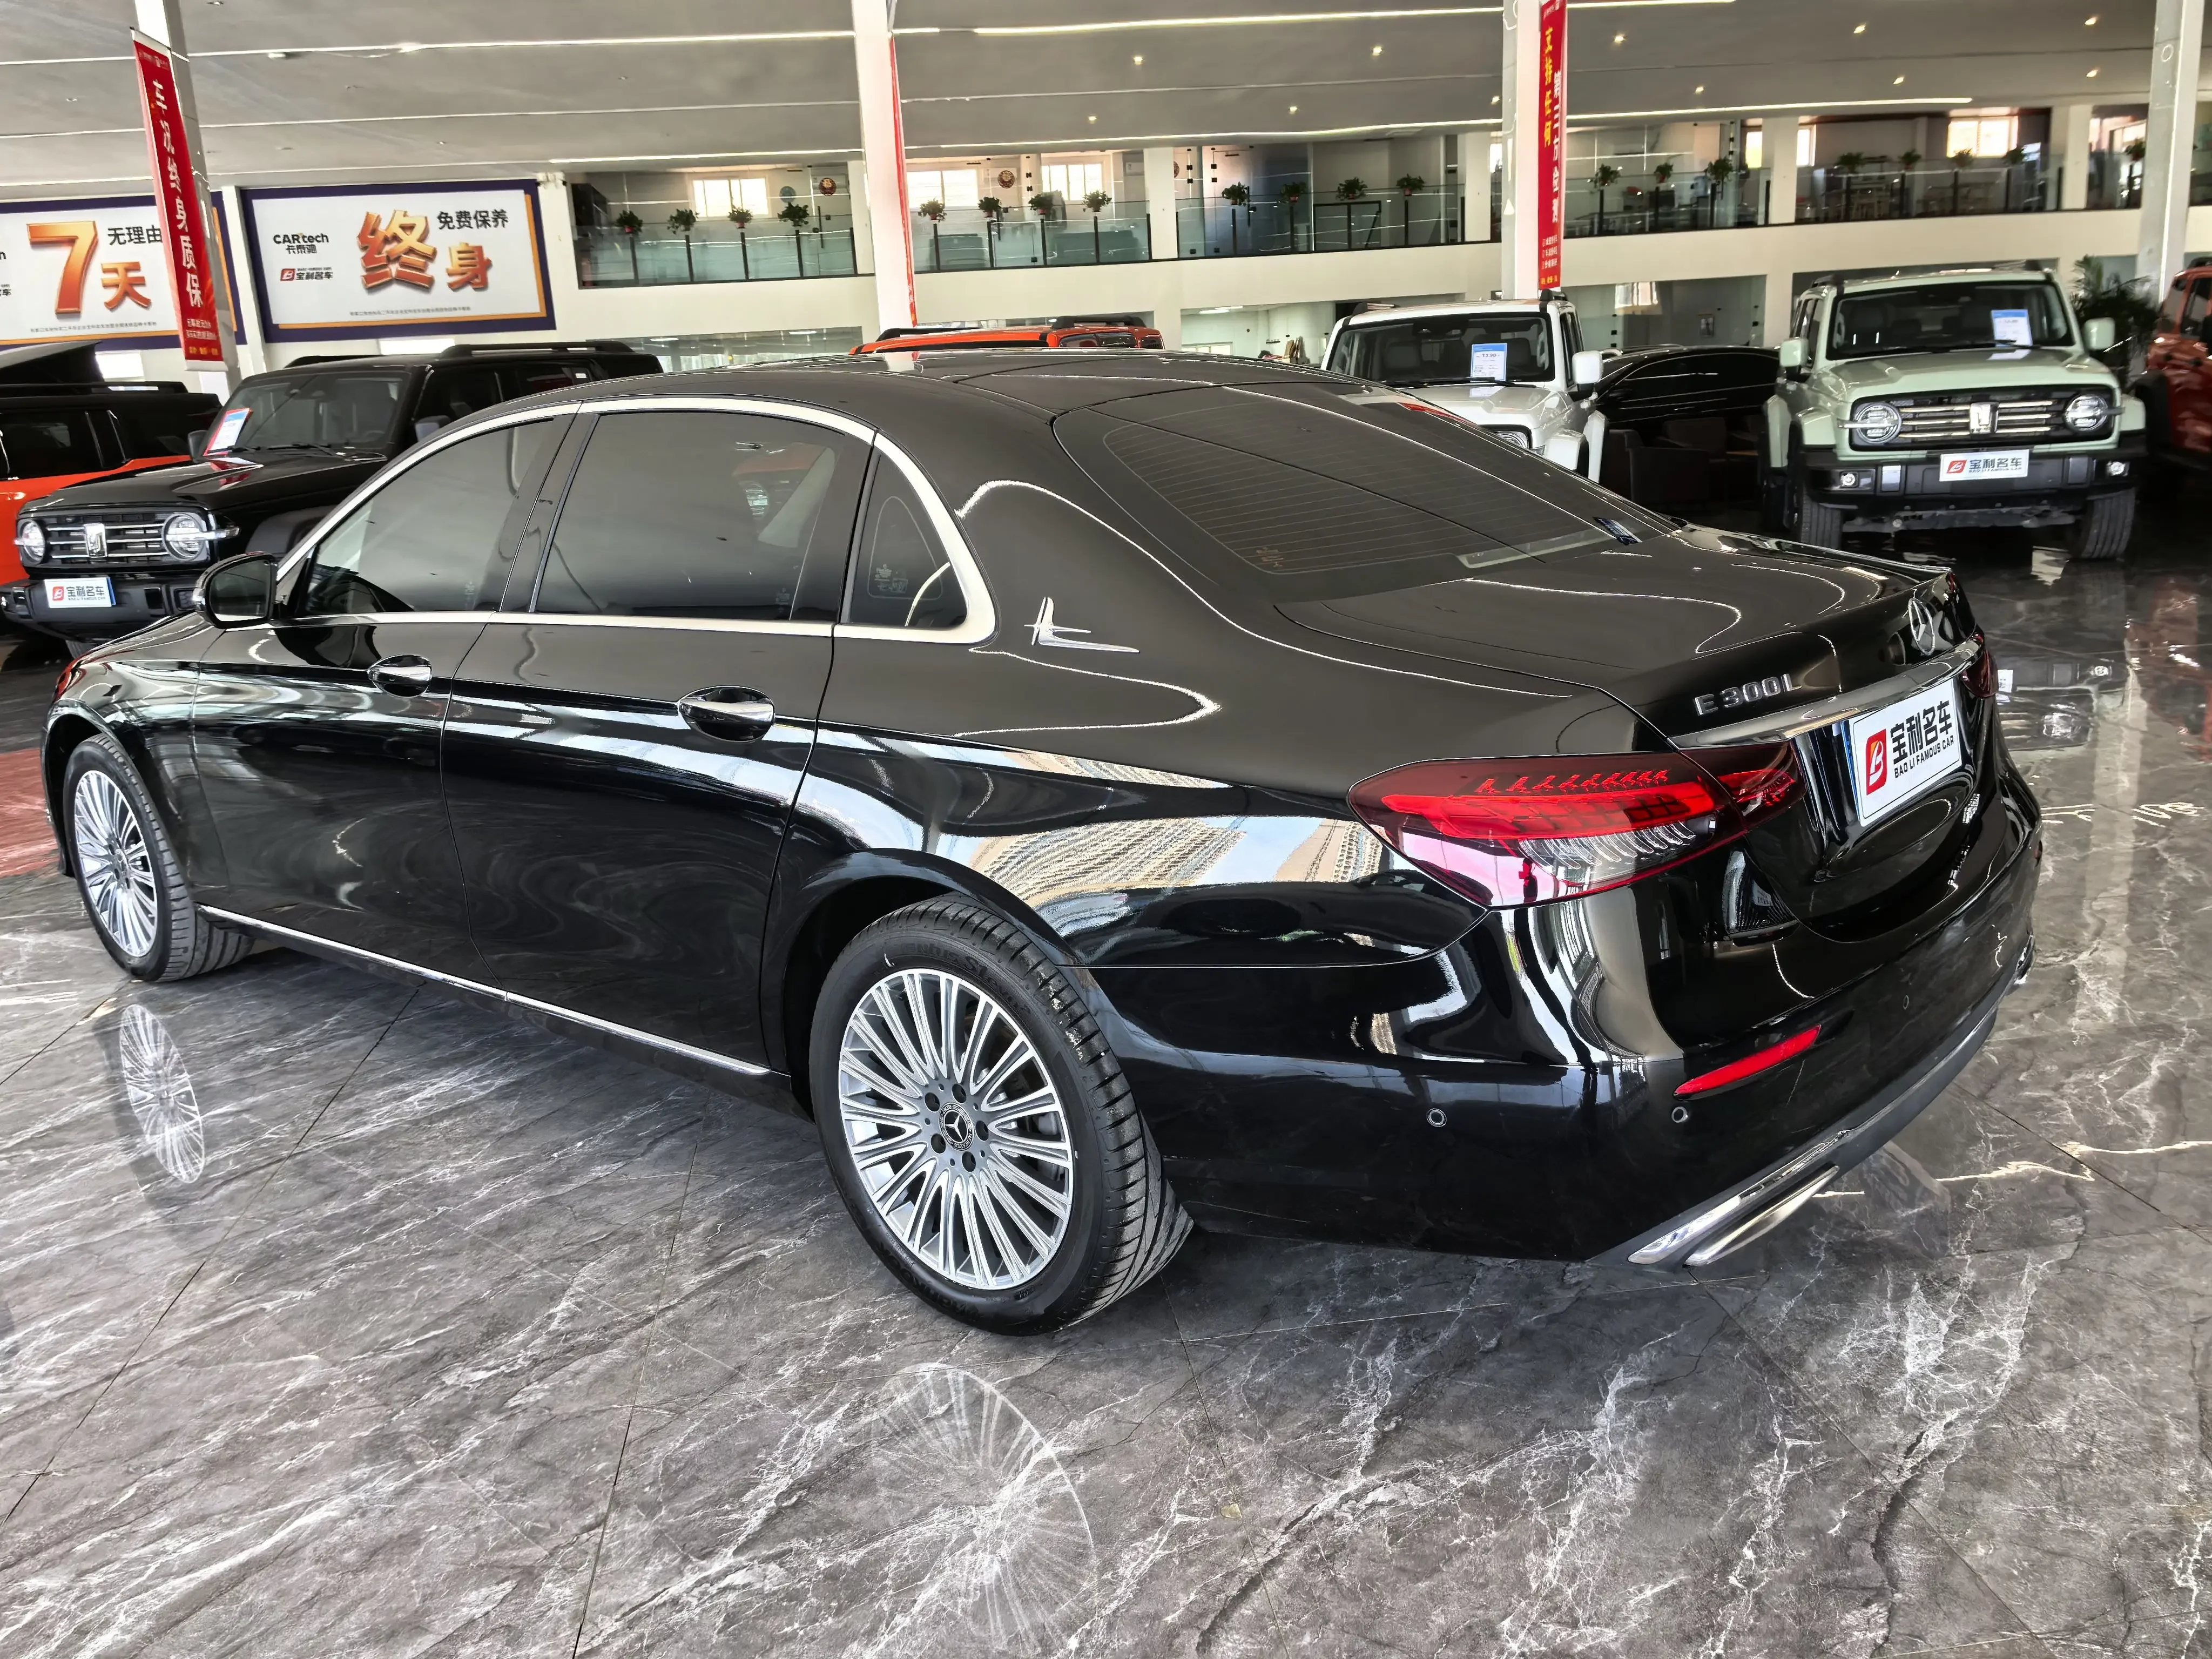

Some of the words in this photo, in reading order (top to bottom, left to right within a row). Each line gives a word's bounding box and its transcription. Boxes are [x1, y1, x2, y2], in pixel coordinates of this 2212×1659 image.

[437, 209, 509, 230] 免费保养
[107, 224, 163, 245] 无理由
[273, 233, 329, 245] CARtech
[357, 210, 493, 291] 终身
[1969, 457, 2022, 469] 宝利名车
[66, 586, 105, 597] 宝利名车
[1694, 693, 1719, 716] E
[1890, 700, 1952, 765] 宝利名车
[1894, 762, 1907, 778] BAO
[1910, 757, 1916, 770] LI
[1917, 743, 1941, 765] FAMOUS
[1943, 735, 1954, 750] CAR
[941, 1104, 952, 1114] BENZ
[954, 1132, 972, 1149] MERCEDES
